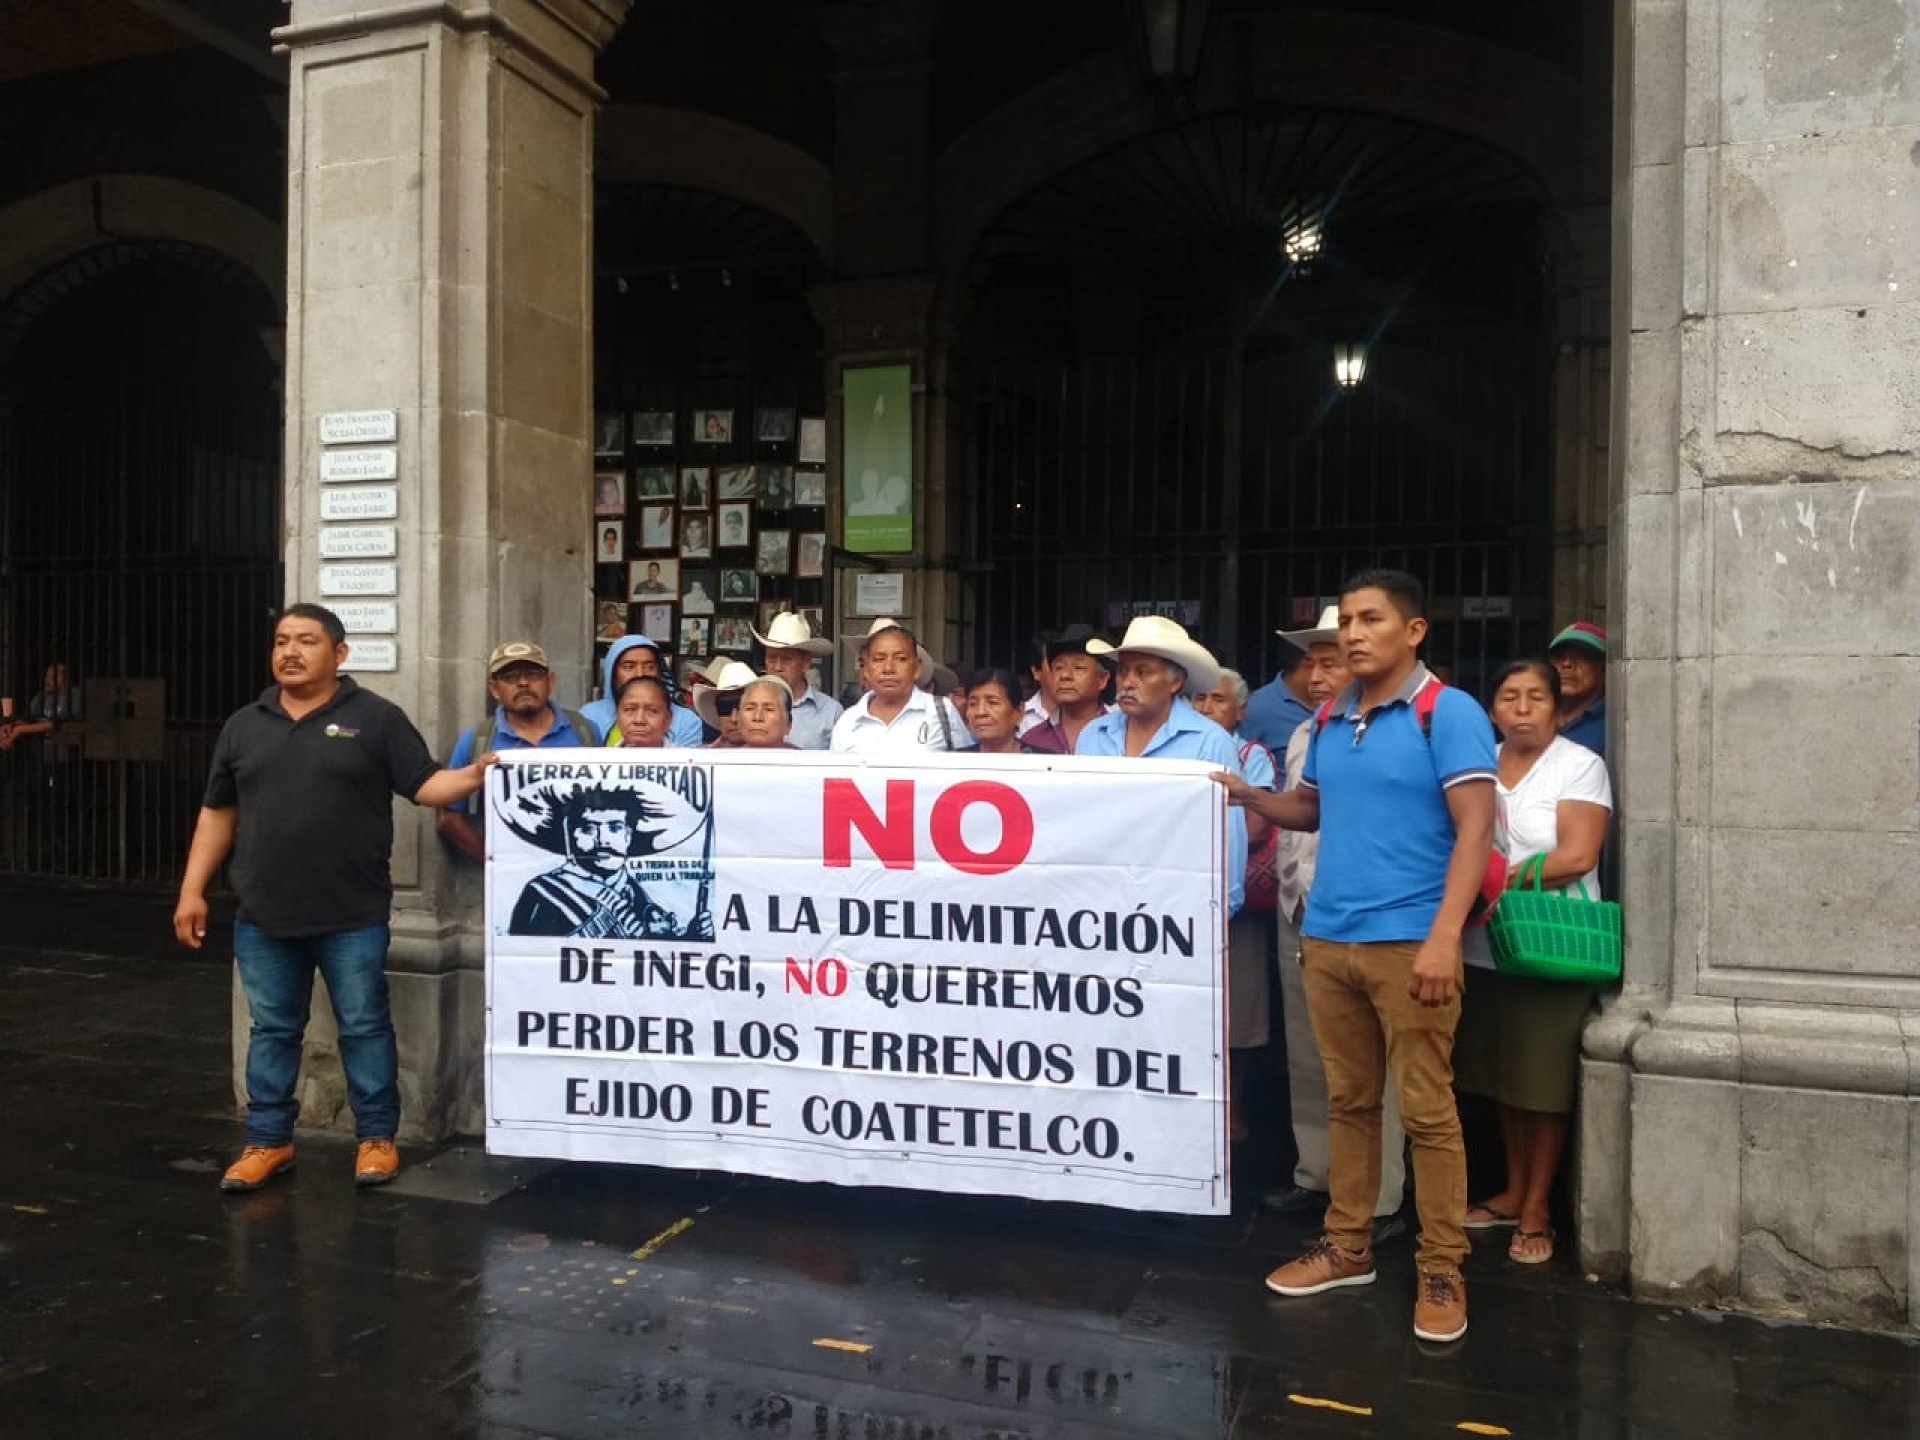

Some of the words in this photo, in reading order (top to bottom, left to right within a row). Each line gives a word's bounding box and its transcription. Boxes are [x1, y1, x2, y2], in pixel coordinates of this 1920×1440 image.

[494, 763, 594, 802] TIERRA
[600, 764, 617, 780] Y
[618, 764, 708, 814] LIBERTAD
[824, 778, 1034, 875] NO
[630, 860, 643, 870] LA
[678, 860, 689, 870] ES
[666, 871, 676, 881] LA
[722, 893, 751, 931] A
[768, 895, 821, 934] LA
[839, 898, 1194, 957] DELIMITACIÓN
[560, 947, 616, 985] DE
[633, 950, 767, 999] INEGI,
[785, 957, 848, 997] NO
[865, 962, 1144, 1018] QUEREMOS
[518, 1010, 694, 1056] PERDER
[713, 1019, 799, 1062] LOS
[814, 1026, 1075, 1084] TERRENOS
[1096, 1047, 1198, 1096] DEL
[566, 1078, 692, 1123] EJIDO
[712, 1086, 772, 1129] DE
[802, 1095, 1134, 1162] COATETELCO.
